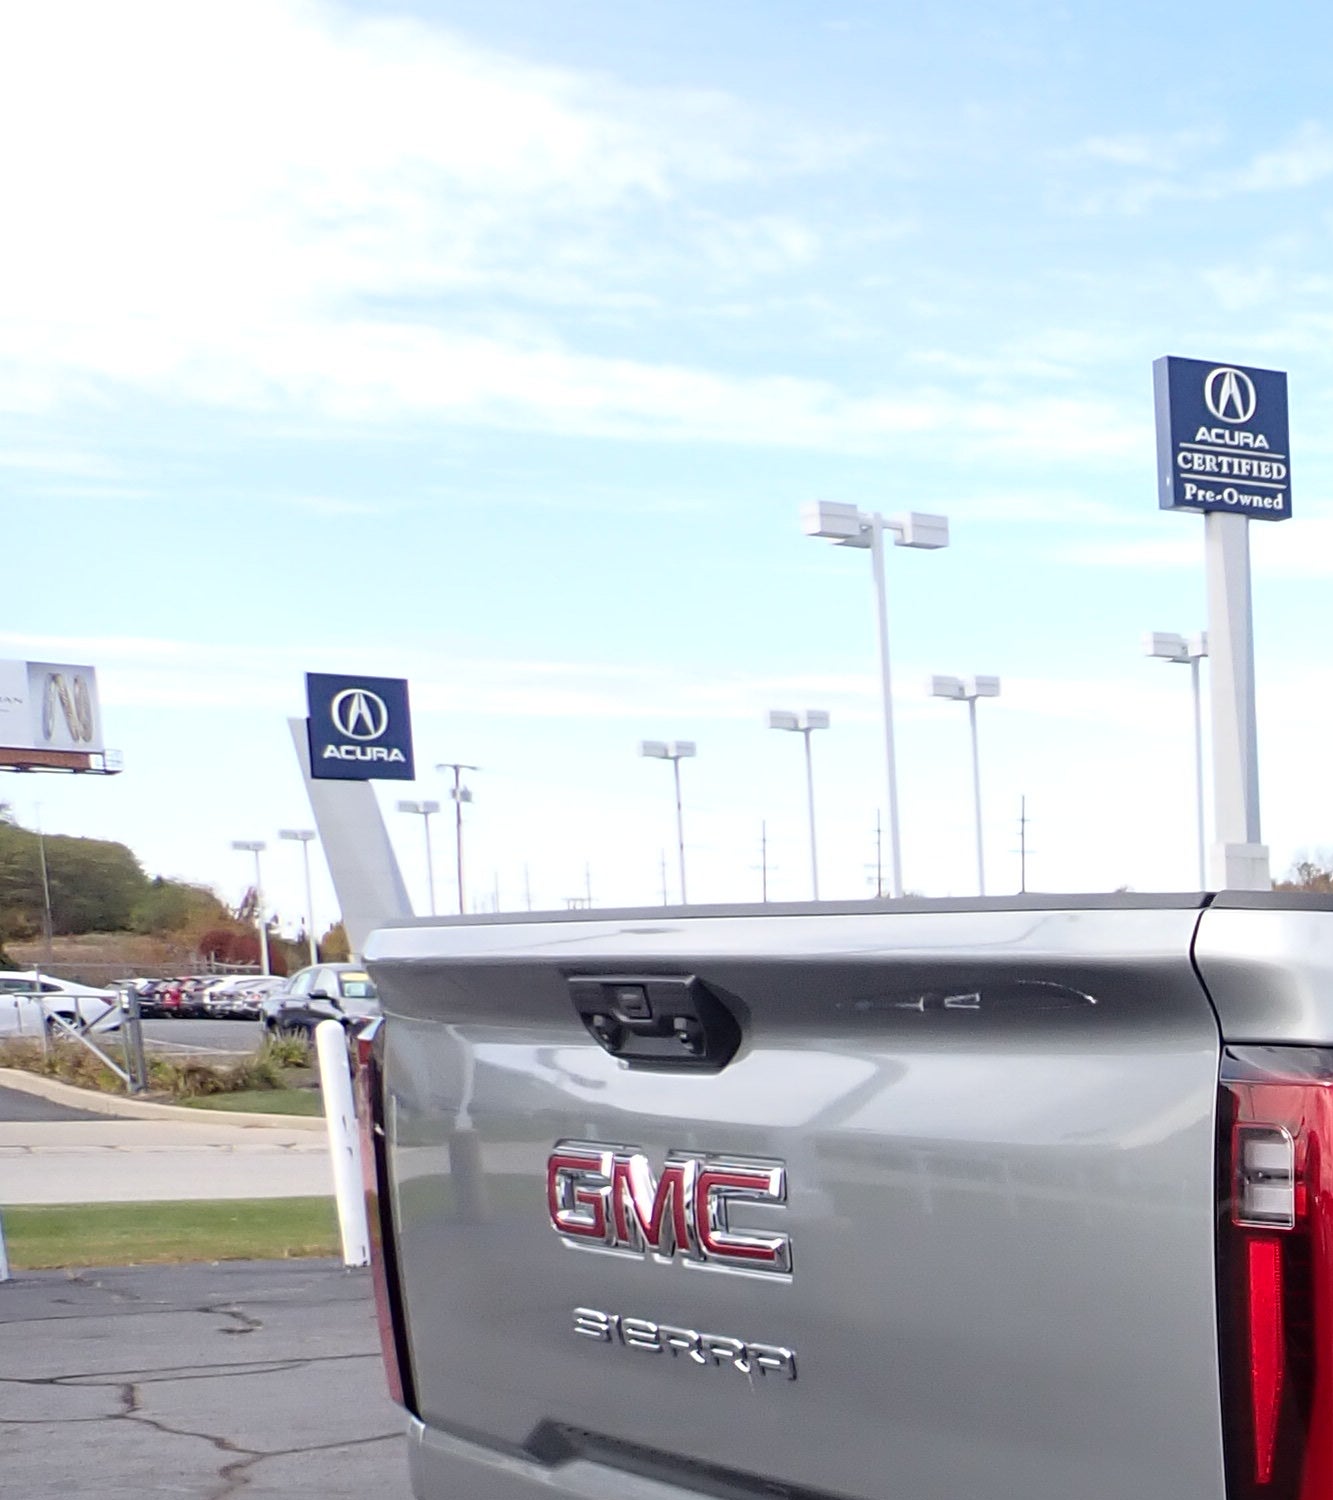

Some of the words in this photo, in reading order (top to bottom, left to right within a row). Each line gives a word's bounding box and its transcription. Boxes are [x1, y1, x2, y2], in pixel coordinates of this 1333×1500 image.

[1195, 426, 1270, 450] ACURA
[1177, 452, 1287, 480] CERTIFIED
[1184, 483, 1284, 510] Pre-Owned
[323, 744, 406, 762] ACURA
[547, 1141, 793, 1277] GMC
[573, 1307, 797, 1380] SIERRA
